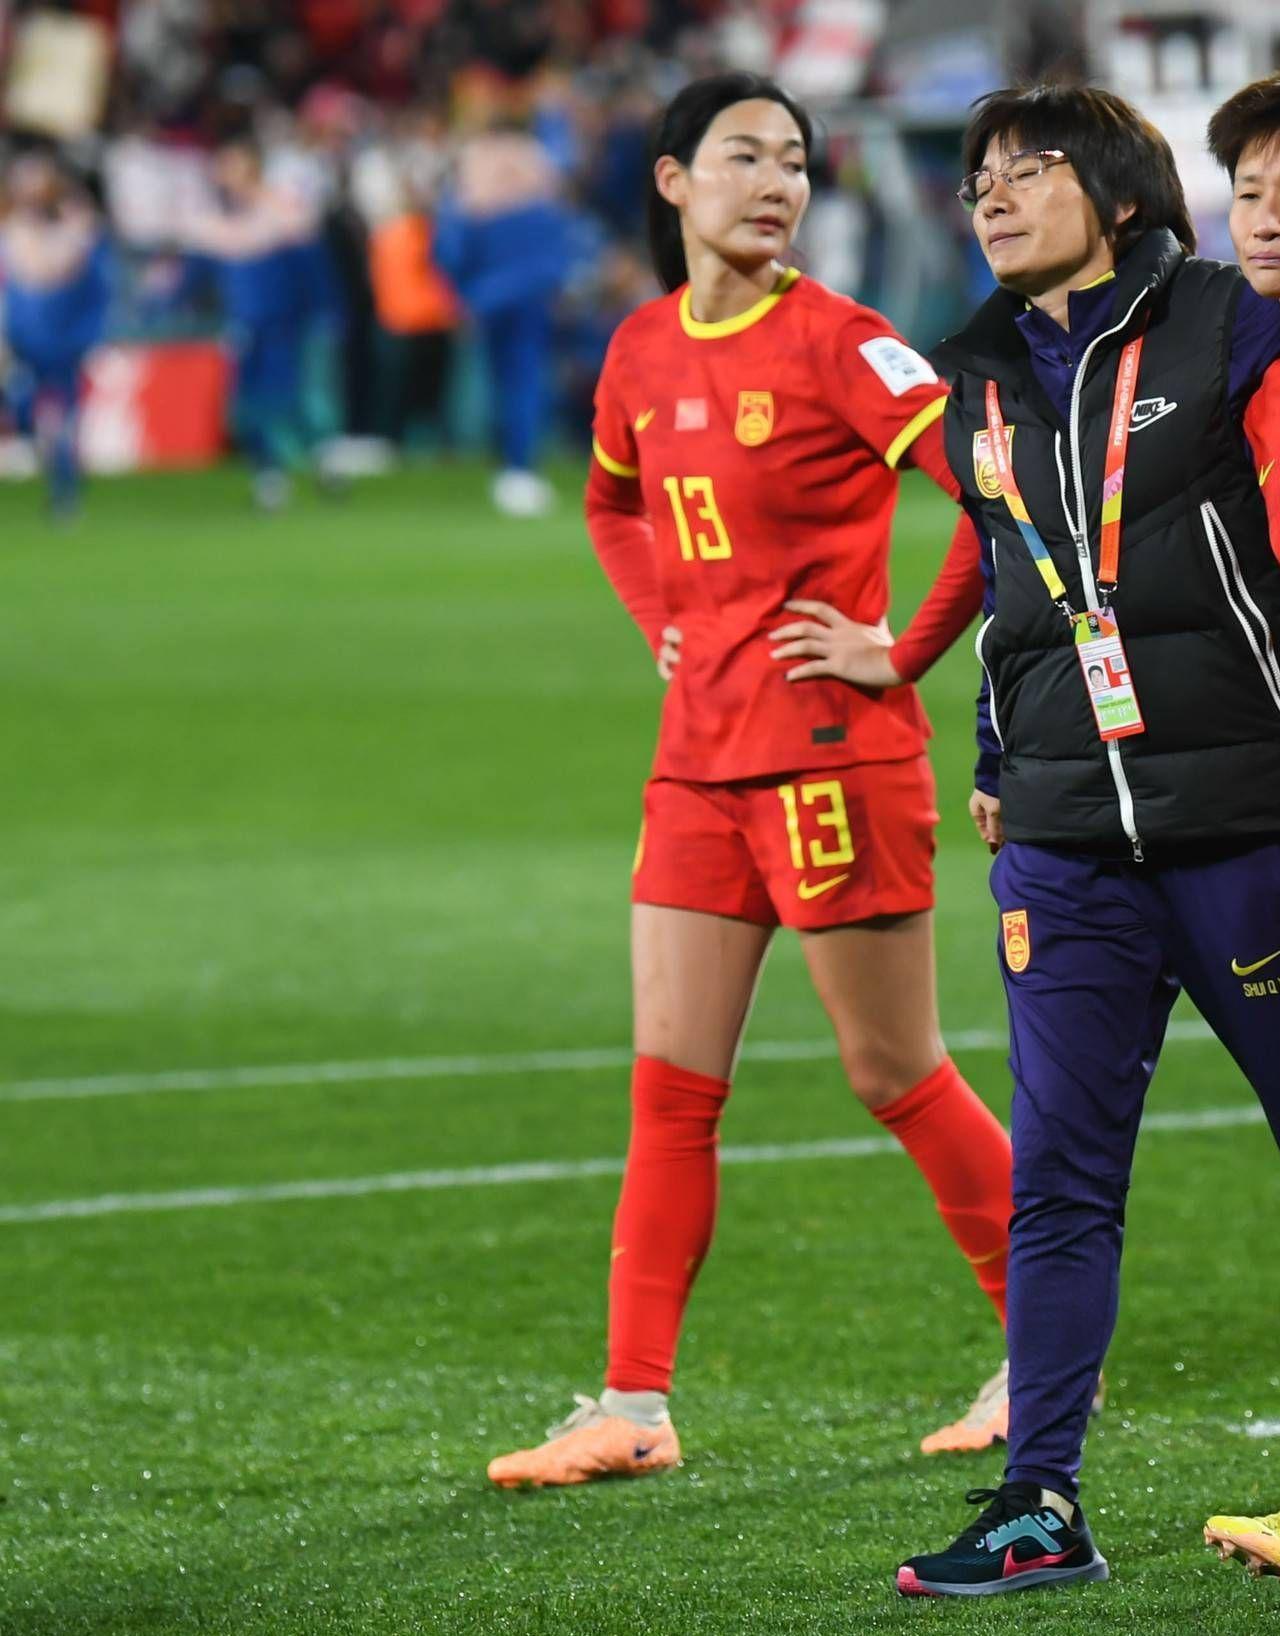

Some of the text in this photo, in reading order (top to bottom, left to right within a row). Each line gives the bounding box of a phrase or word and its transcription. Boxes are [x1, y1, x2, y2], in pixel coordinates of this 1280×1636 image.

[1133, 401, 1163, 417] NIKE
[663, 476, 732, 561] 13
[777, 780, 855, 869] 13
[1242, 981, 1267, 998] SHUI
[1267, 979, 1279, 994] Q
